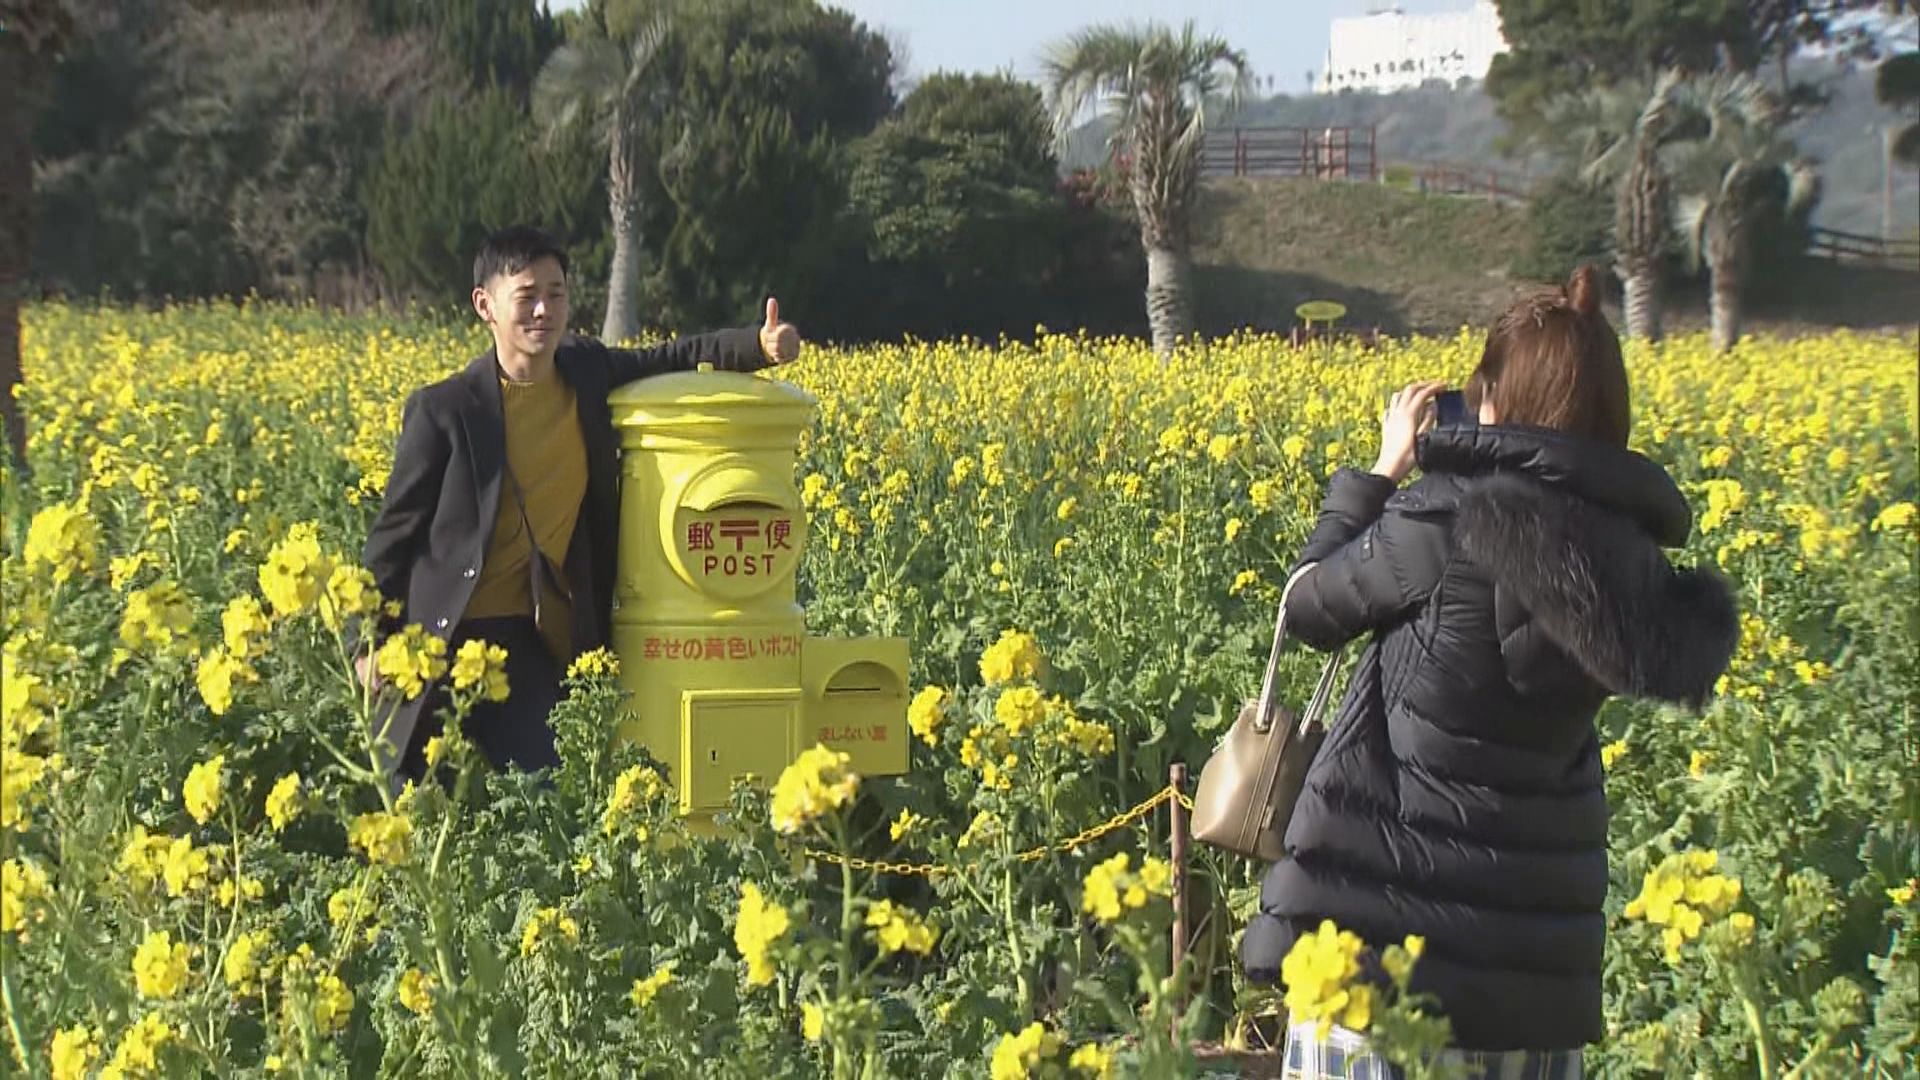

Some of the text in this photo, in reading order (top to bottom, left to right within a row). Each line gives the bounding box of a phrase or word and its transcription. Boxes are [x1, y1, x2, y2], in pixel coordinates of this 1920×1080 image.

[704, 555, 775, 575] POST
[643, 635, 800, 660] 幸せの黄色いポスト
